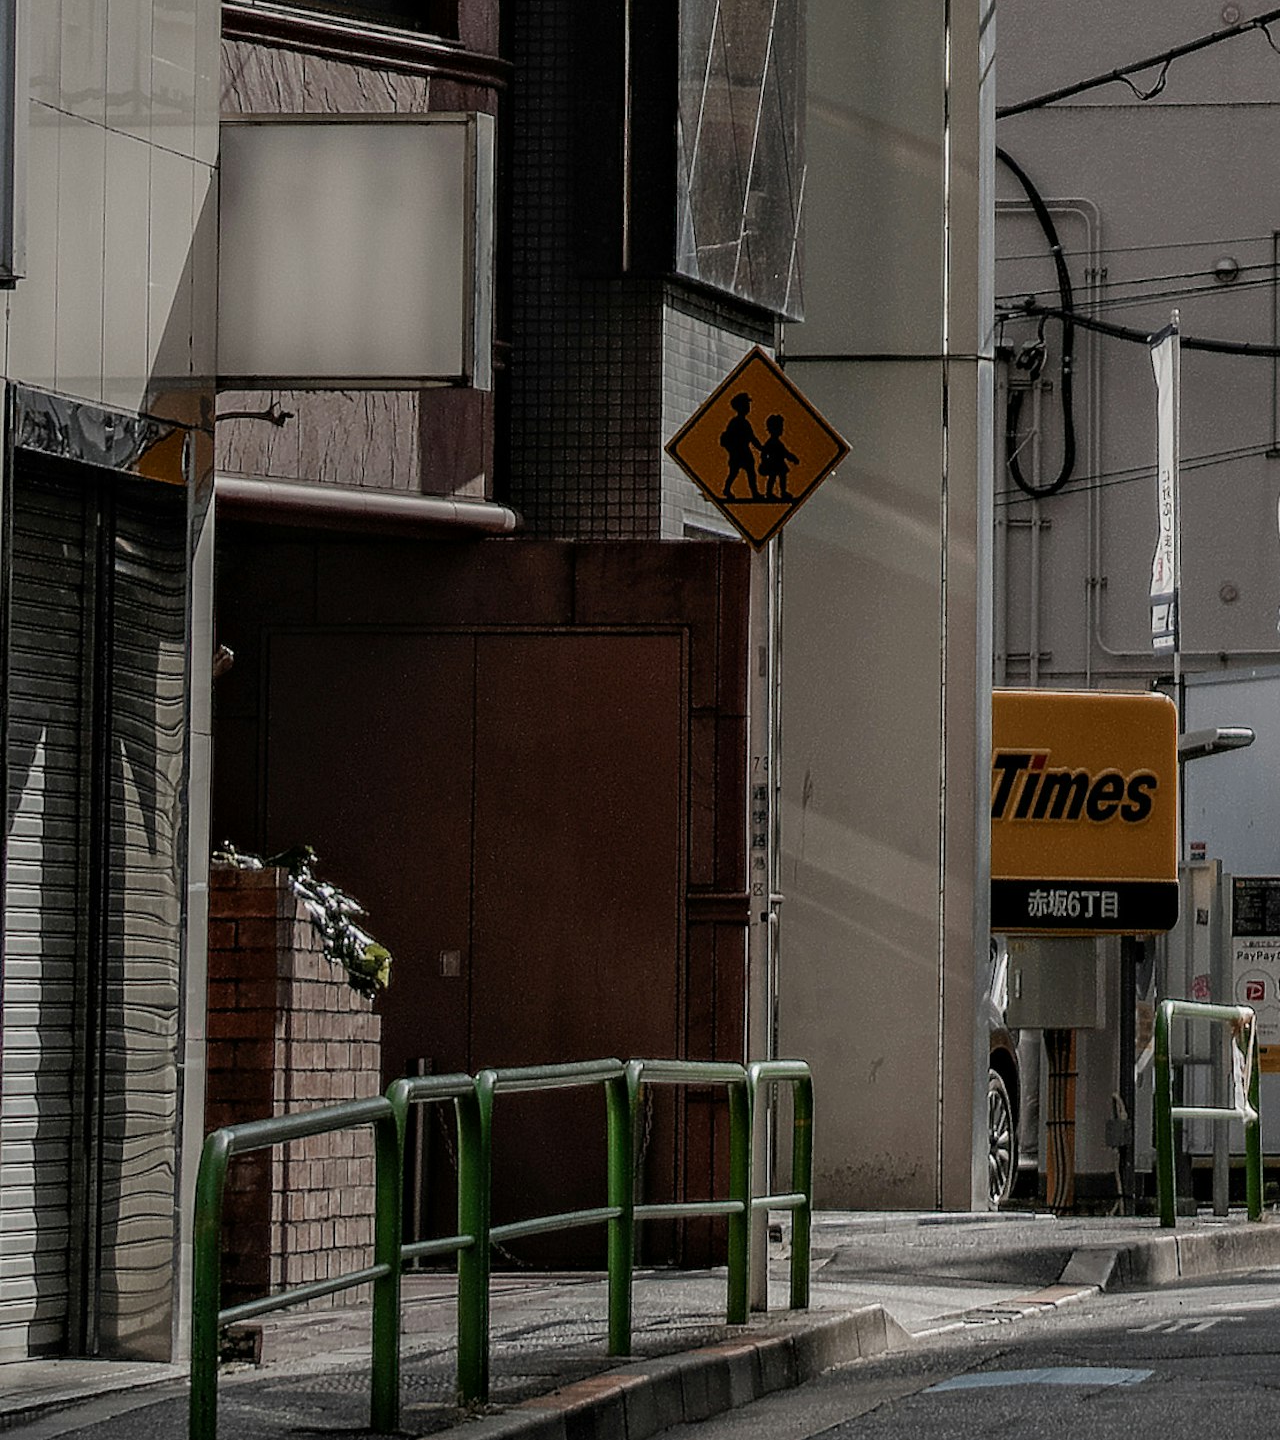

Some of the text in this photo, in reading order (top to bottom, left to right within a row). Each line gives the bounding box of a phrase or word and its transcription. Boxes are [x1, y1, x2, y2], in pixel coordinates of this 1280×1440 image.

[991, 751, 1158, 823] Times
[1028, 888, 1119, 918] 赤坂6丁目
